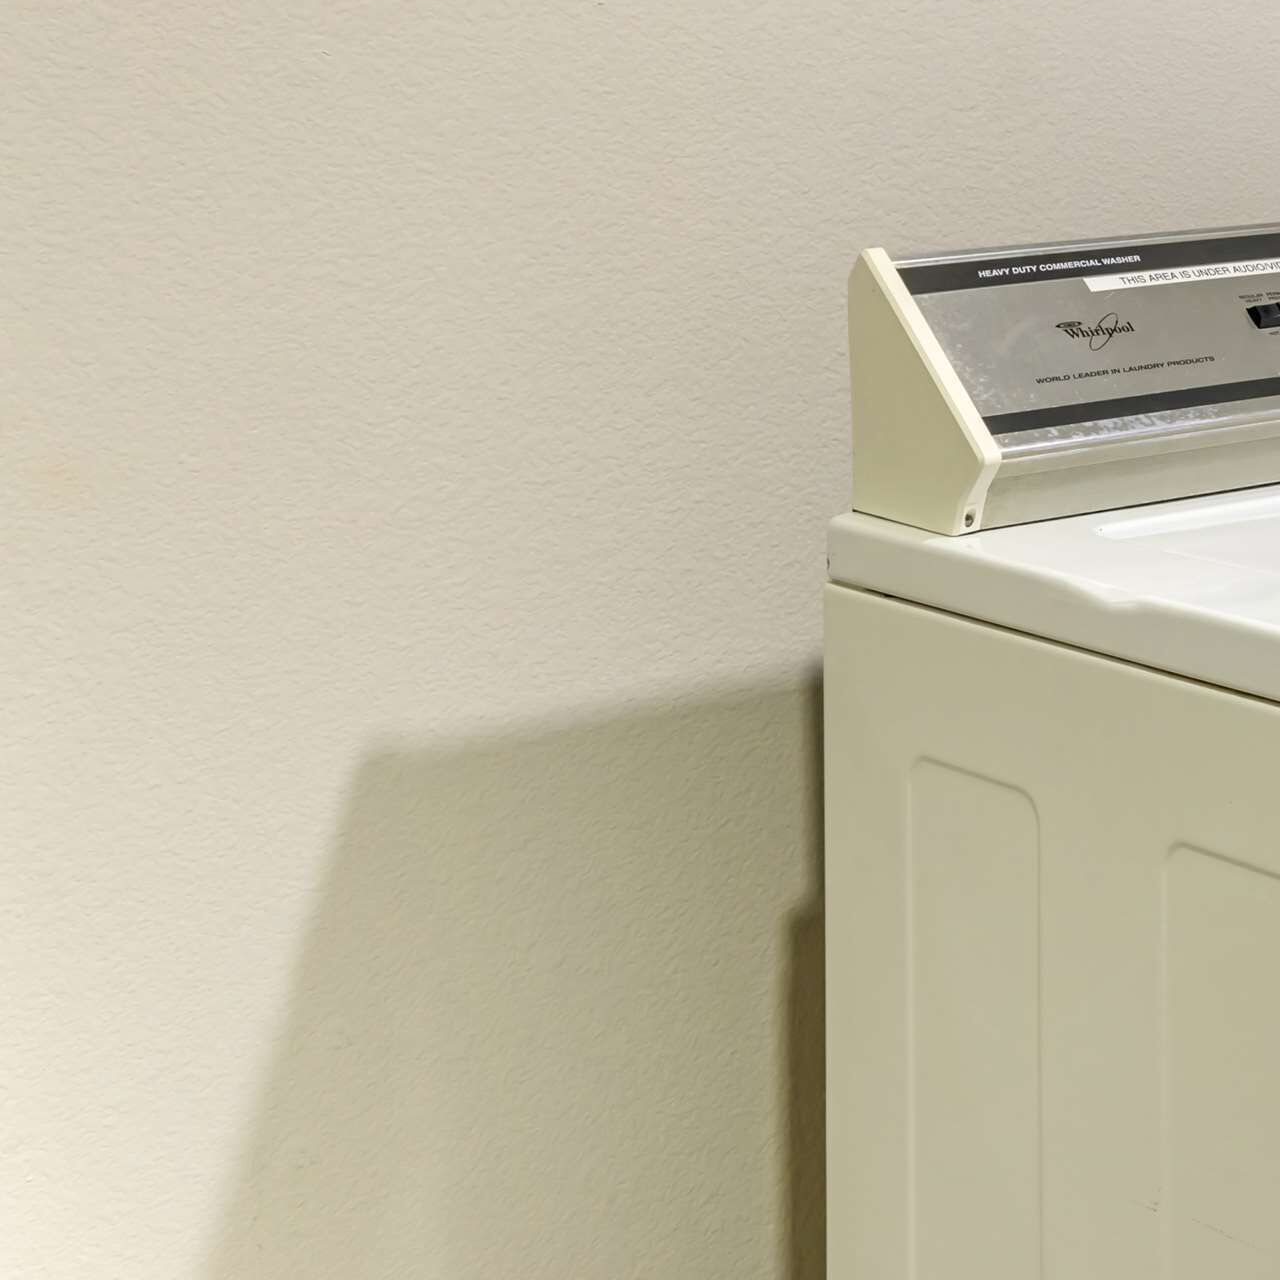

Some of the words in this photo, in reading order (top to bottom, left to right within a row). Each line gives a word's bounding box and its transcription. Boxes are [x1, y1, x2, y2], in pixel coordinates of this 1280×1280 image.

[978, 268, 1010, 278] HEAVY
[1012, 265, 1037, 274] DUTY
[1040, 258, 1102, 272] COMMERCIAL
[1102, 255, 1141, 265] WASHER
[1120, 274, 1146, 286] THIS
[1149, 272, 1178, 282] AREA
[1179, 270, 1192, 280] IS
[1193, 265, 1230, 278] UNDER
[1064, 322, 1135, 339] Whirlpool
[1036, 374, 1070, 384] WORLD
[1073, 369, 1109, 380] LEADER
[1123, 362, 1165, 373] LAUNDRY
[1167, 356, 1216, 367] PRODUCTS
